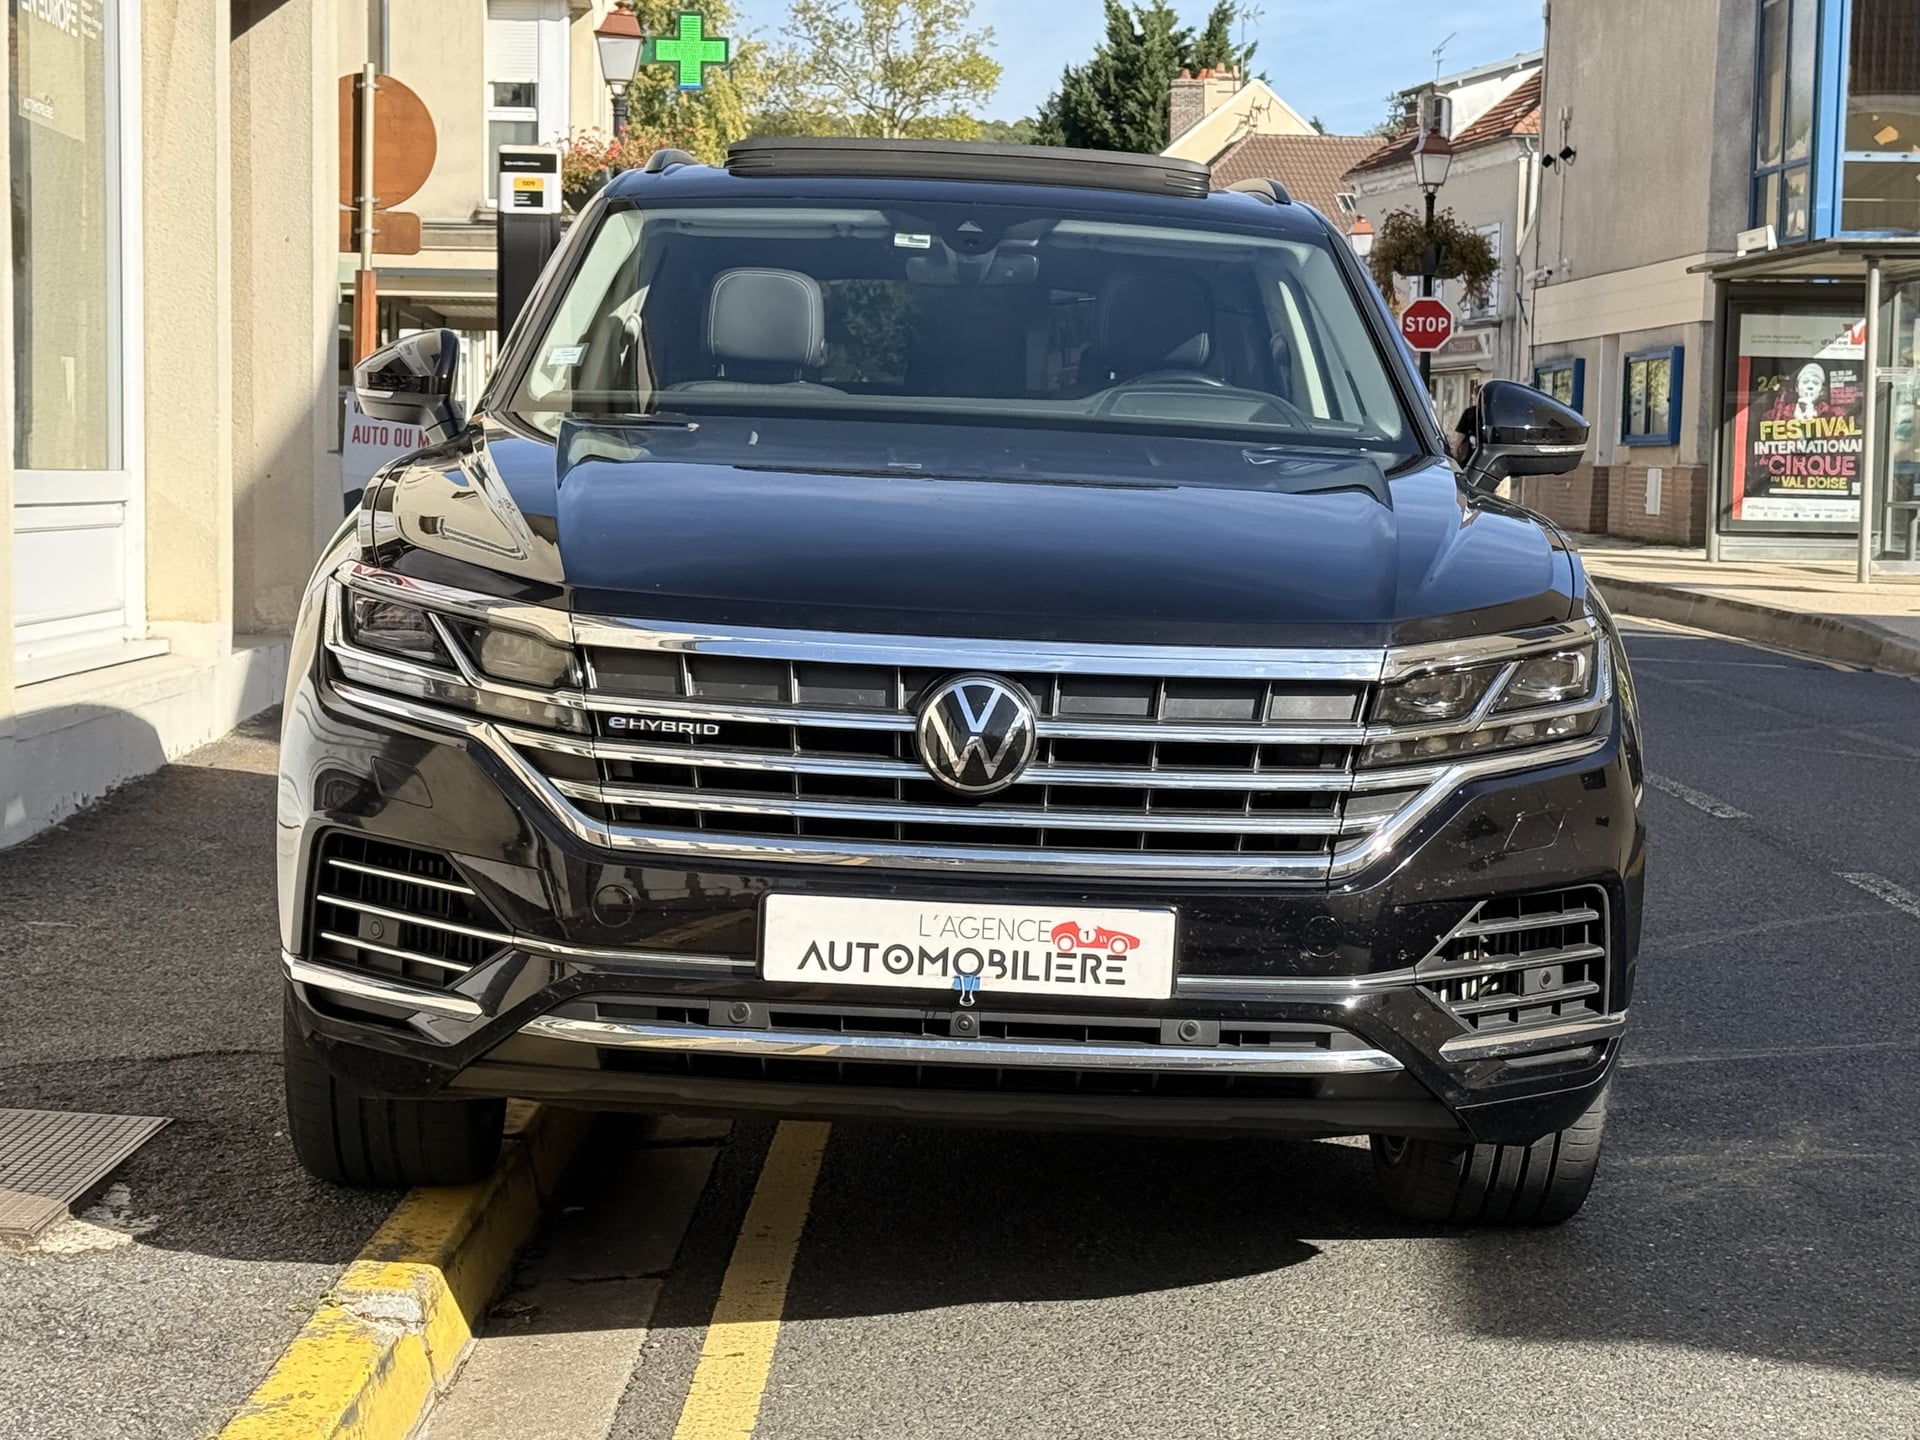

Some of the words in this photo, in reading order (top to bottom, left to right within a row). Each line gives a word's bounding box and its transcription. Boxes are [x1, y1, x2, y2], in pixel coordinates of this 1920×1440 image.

[1405, 316, 1449, 332] STOP
[352, 424, 388, 446] AUTO
[394, 428, 412, 448] OU
[1760, 416, 1863, 440] FESTIVAL
[1769, 455, 1856, 475] CIRQUE
[1782, 476, 1805, 488] VAL
[919, 913, 1053, 943] L'AGENCE
[797, 940, 1128, 985] AUTOMOBILIERE
